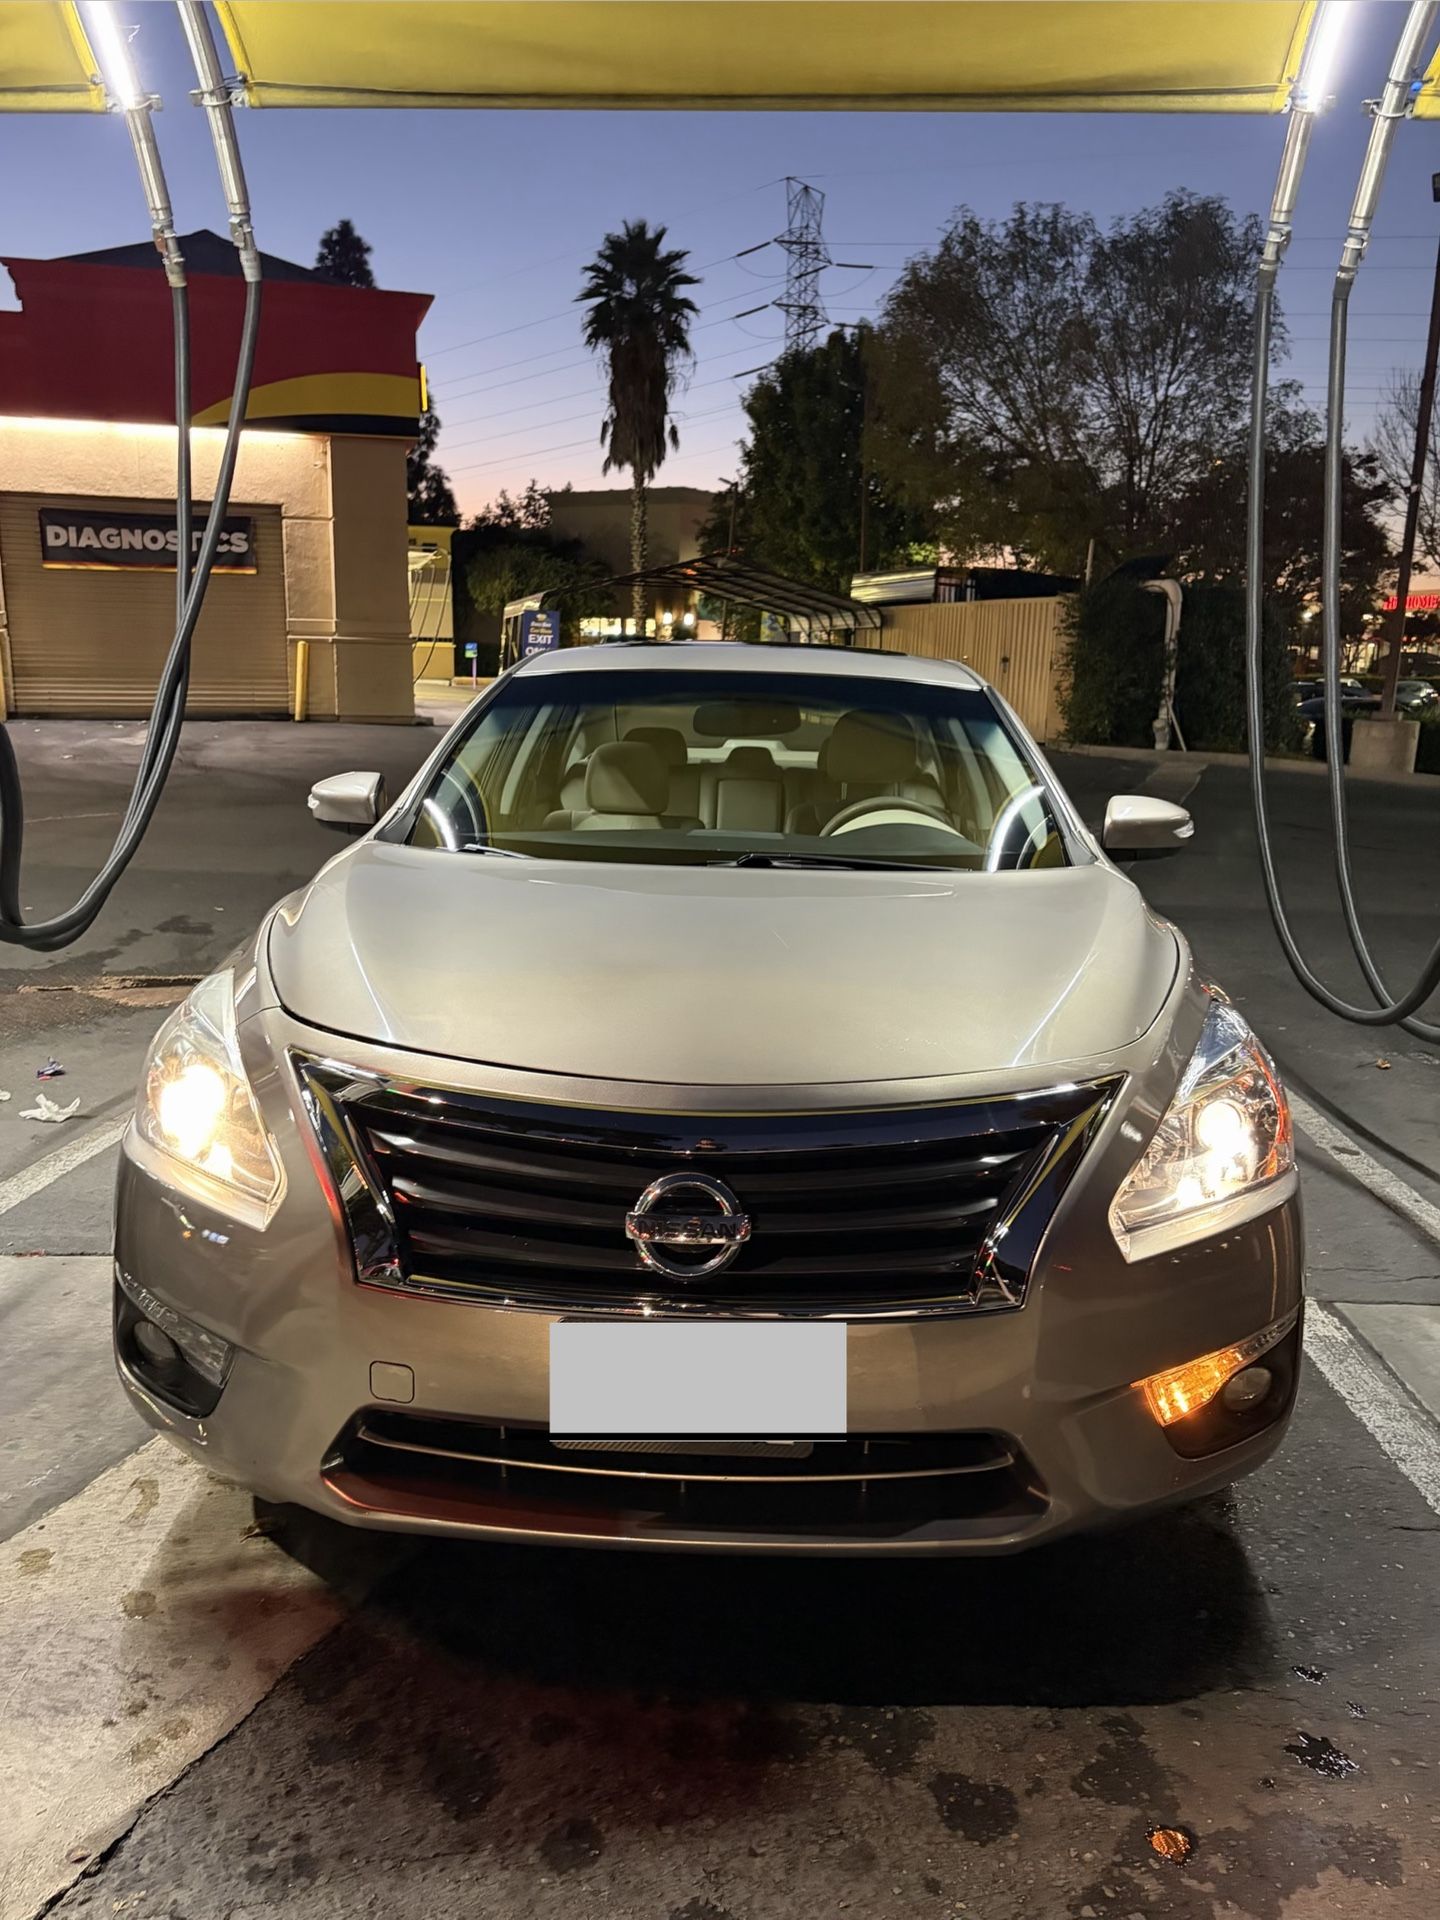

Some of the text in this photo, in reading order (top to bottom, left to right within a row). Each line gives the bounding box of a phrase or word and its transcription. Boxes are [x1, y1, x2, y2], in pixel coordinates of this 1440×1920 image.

[46, 525, 249, 553] DIAGNOSTCS
[1406, 595, 1440, 609] HOME
[528, 634, 554, 645] EXIT
[639, 1220, 737, 1240] NISSAN
